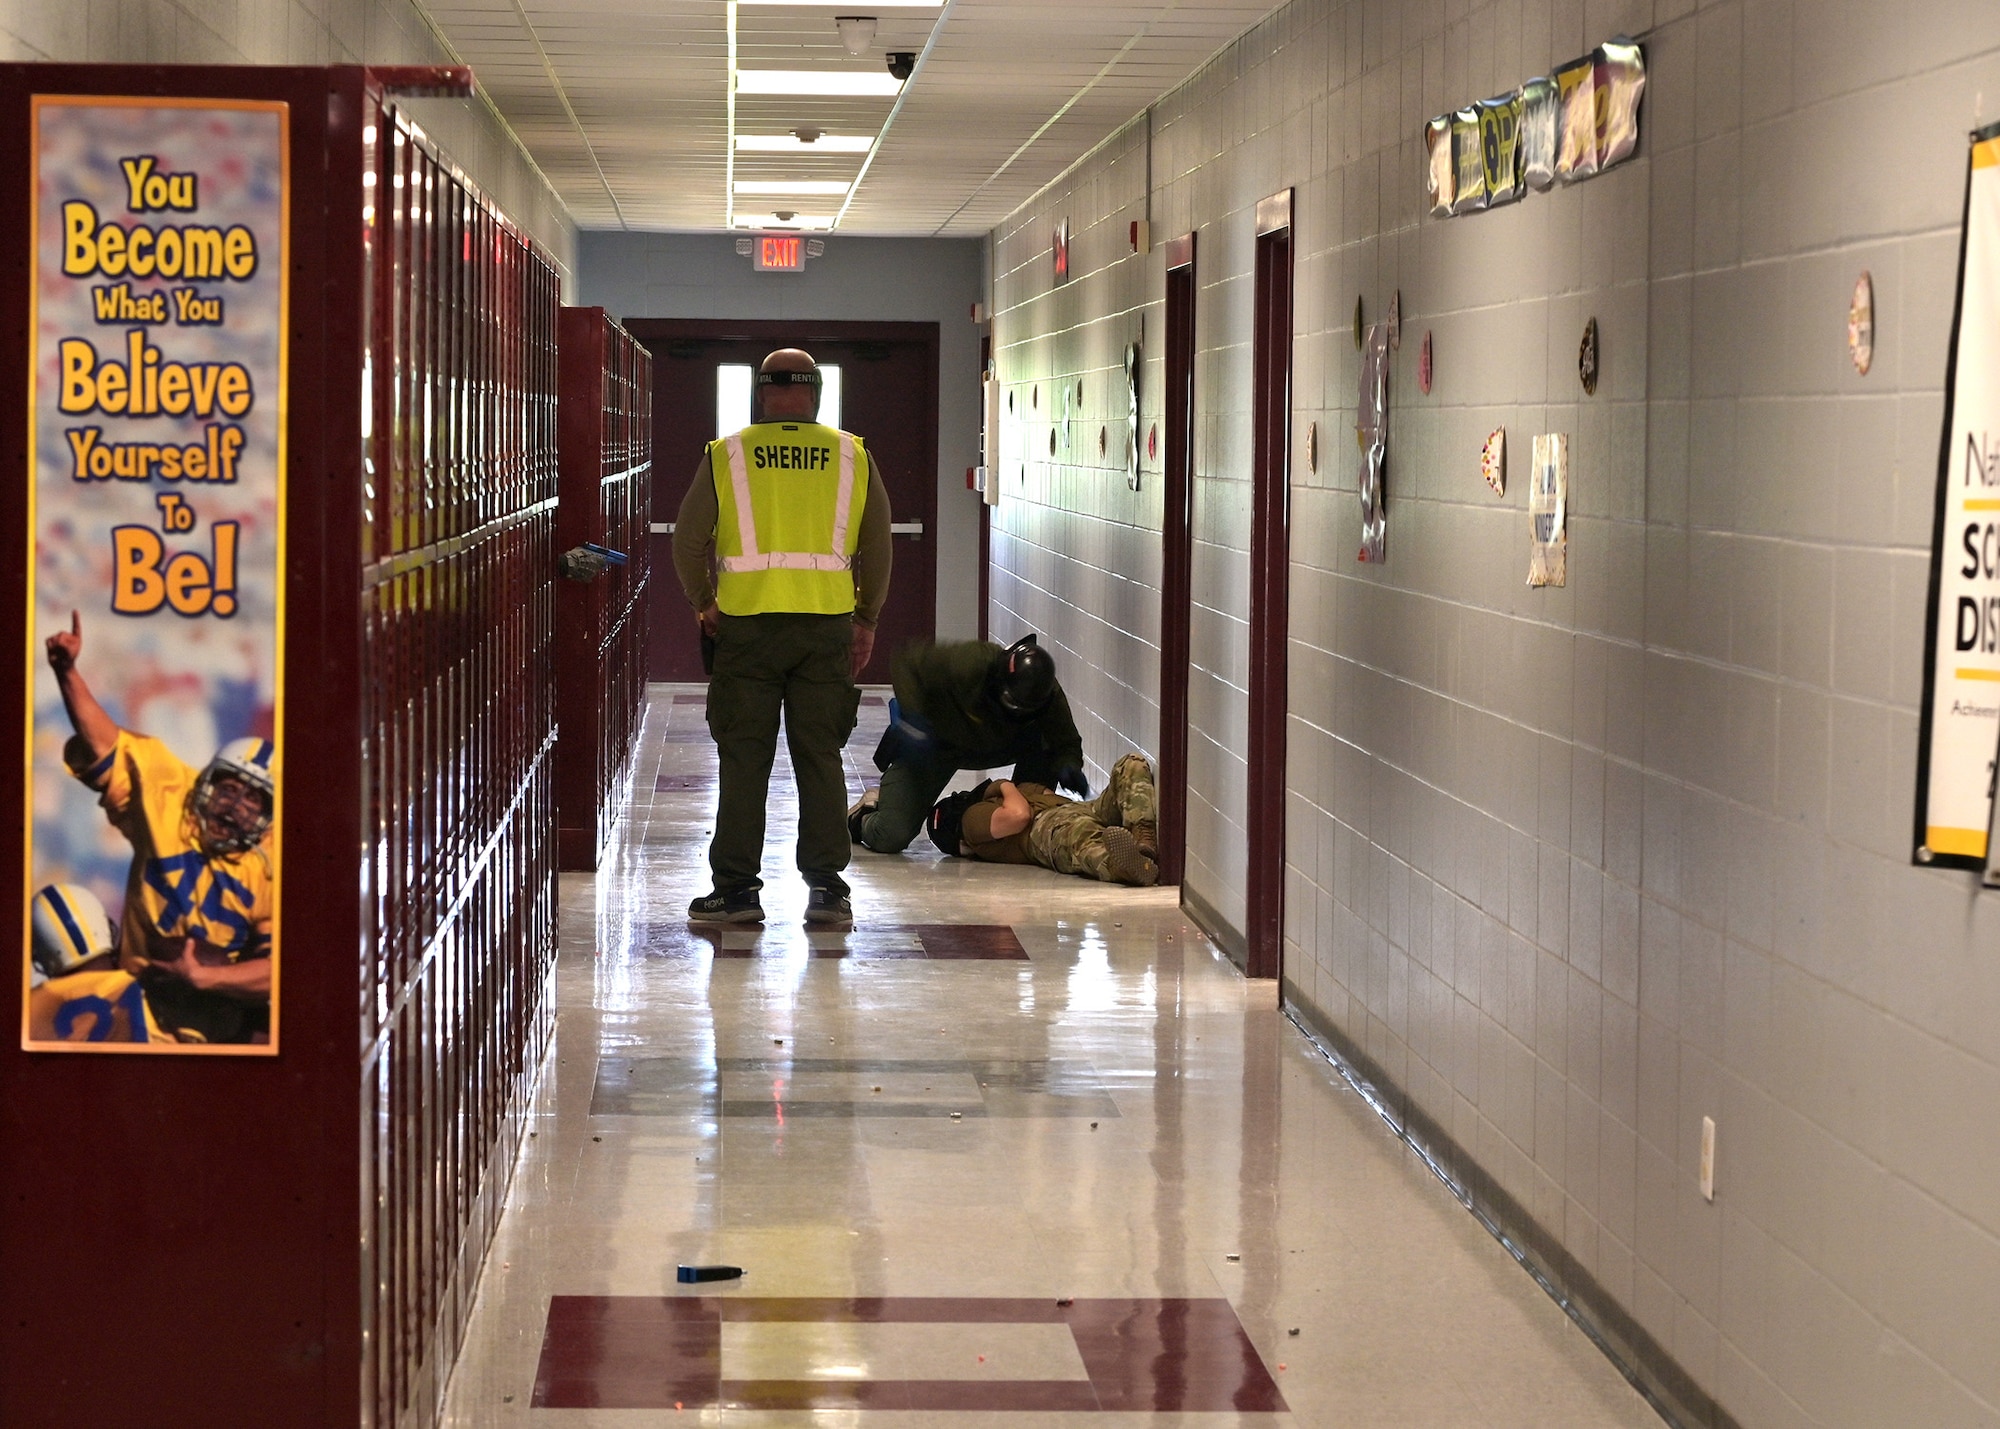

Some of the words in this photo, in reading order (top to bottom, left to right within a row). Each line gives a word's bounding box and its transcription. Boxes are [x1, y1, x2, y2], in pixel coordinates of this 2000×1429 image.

[122, 157, 196, 211] You
[62, 202, 256, 279] Become
[762, 238, 800, 267] EXIT
[93, 284, 165, 323] What
[175, 287, 221, 322] You
[59, 330, 251, 416] Believe
[67, 425, 244, 482] Yourself
[754, 445, 830, 471] SHERIFF
[158, 494, 195, 532] To
[112, 522, 239, 617] Be!
[144, 850, 255, 950] 45
[703, 897, 725, 910] HOKA
